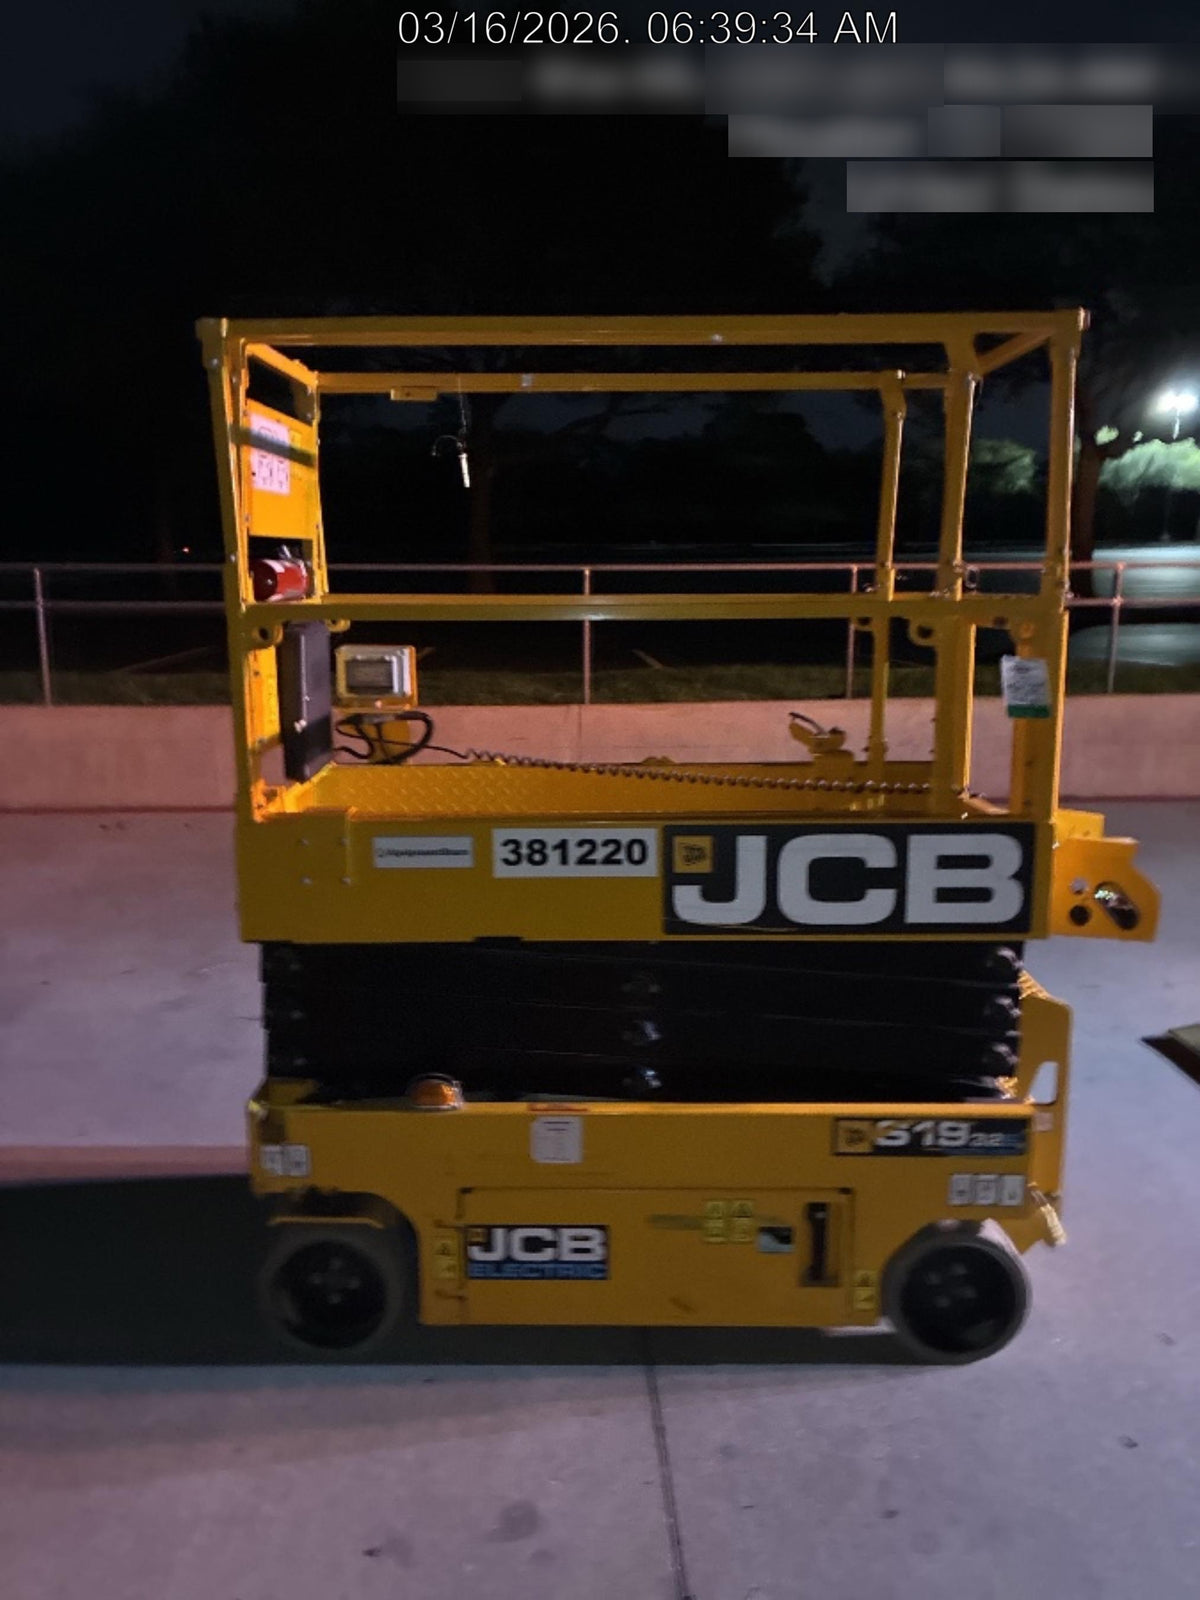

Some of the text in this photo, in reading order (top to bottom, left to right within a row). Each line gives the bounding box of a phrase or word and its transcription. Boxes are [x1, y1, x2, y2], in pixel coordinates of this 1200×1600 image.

[501, 838, 649, 867] 381220
[672, 833, 1025, 926] JCB
[467, 1227, 606, 1262] JCB
